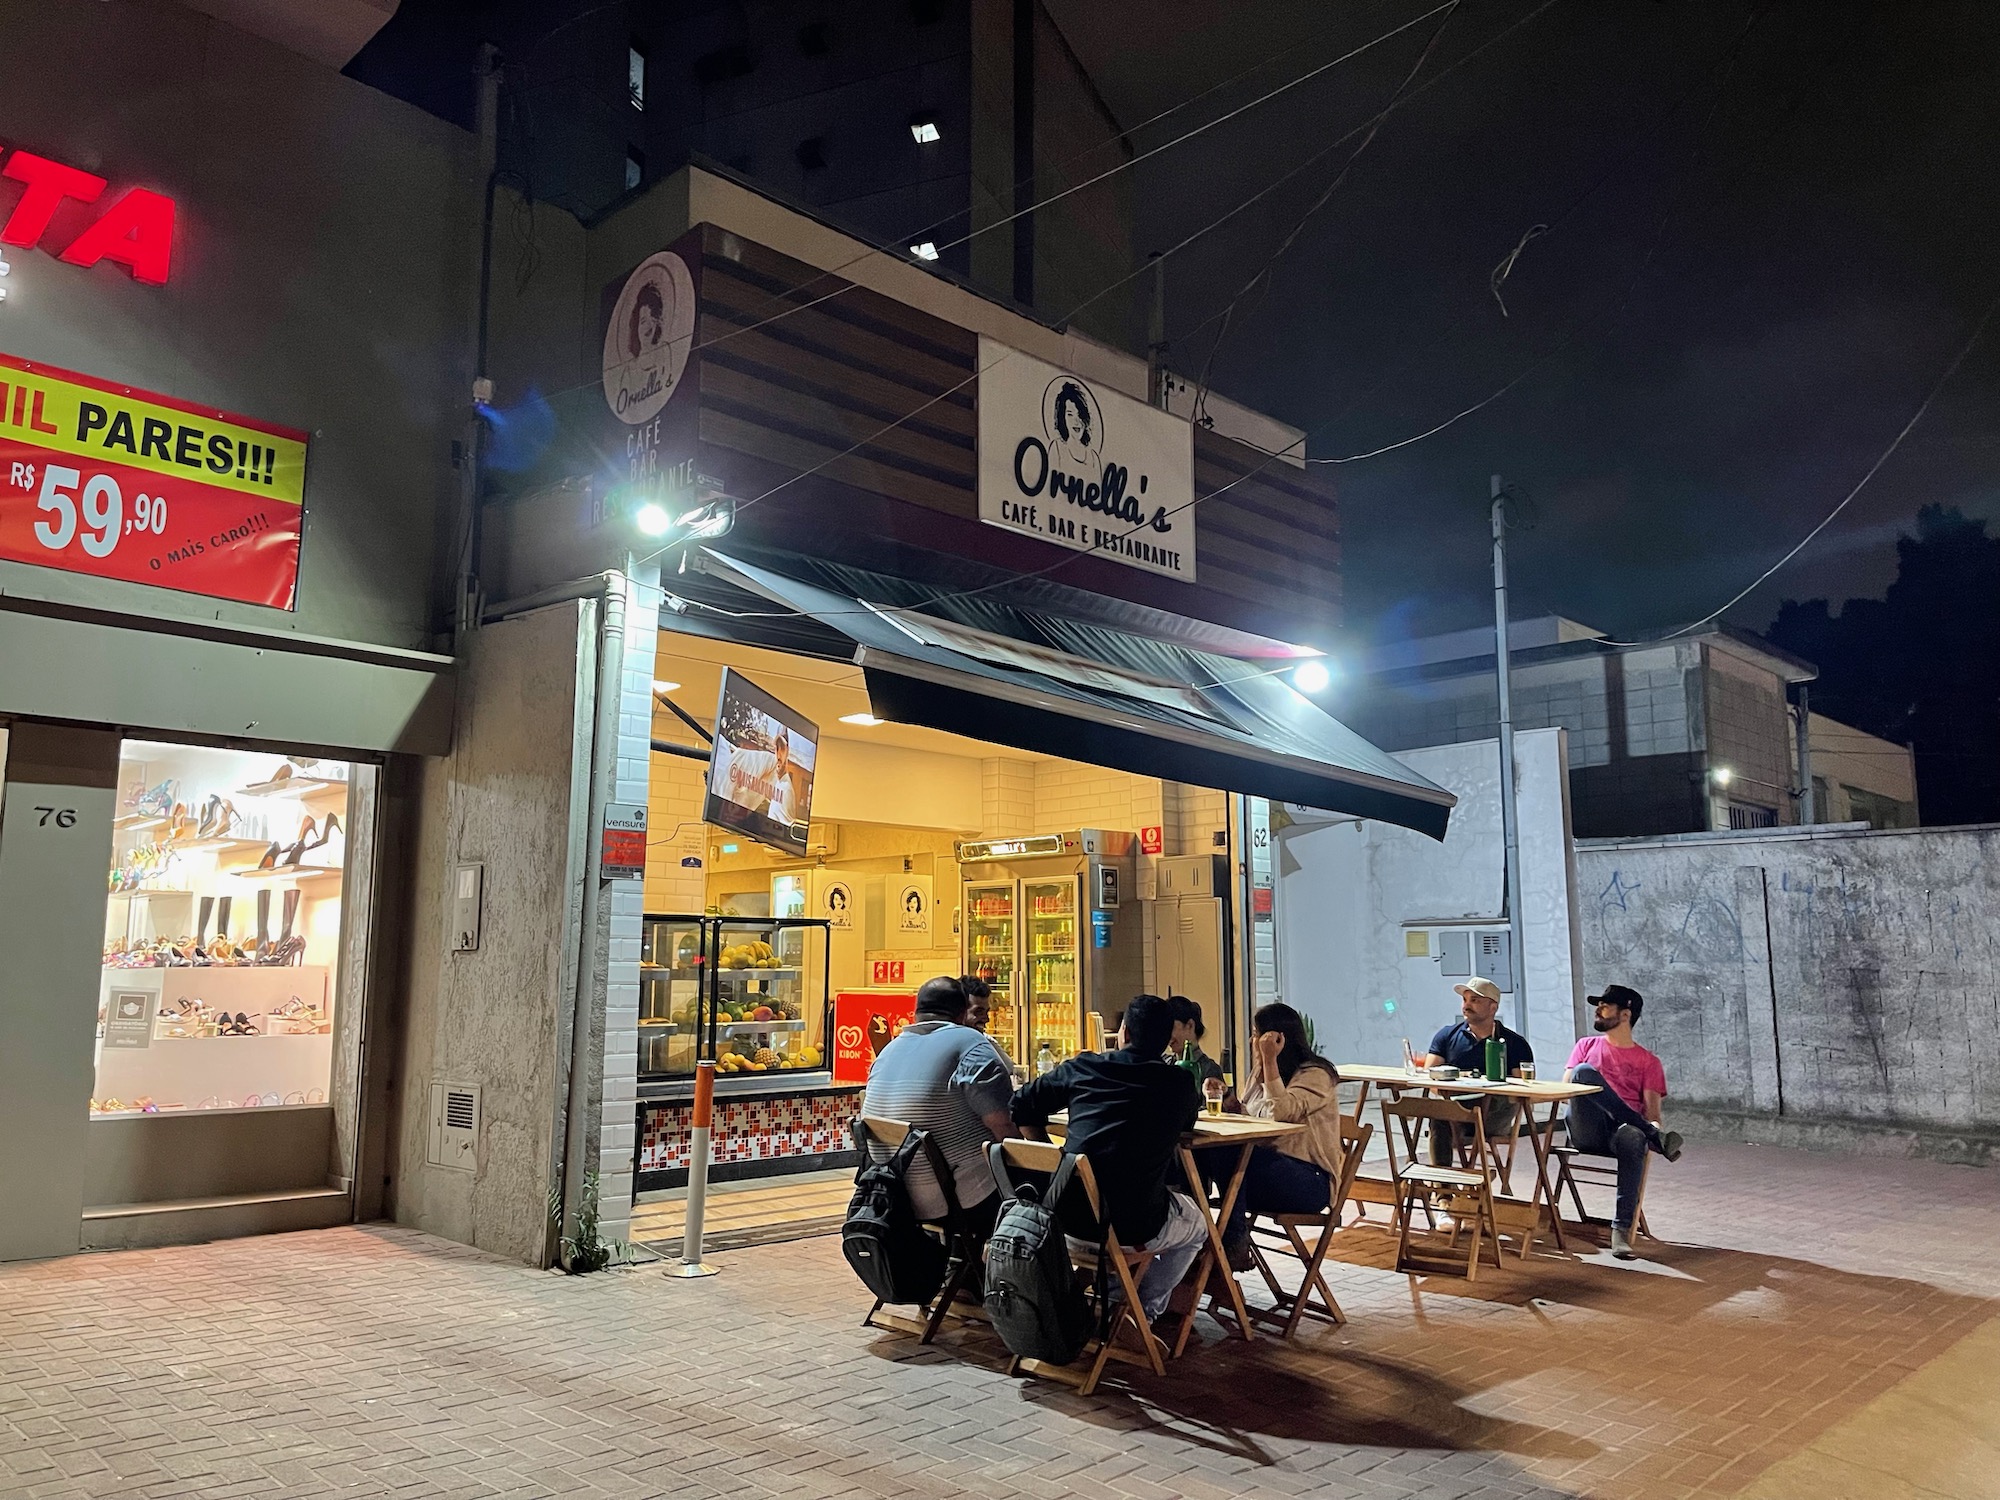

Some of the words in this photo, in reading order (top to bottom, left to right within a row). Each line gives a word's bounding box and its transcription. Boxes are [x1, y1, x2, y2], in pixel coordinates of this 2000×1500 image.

[0, 145, 176, 286] TA
[616, 366, 674, 415] Ornella's
[0, 381, 58, 435] IL
[76, 401, 275, 485] PARES!!!
[627, 416, 661, 458] CAFÉ
[10, 462, 35, 492] R$
[630, 449, 657, 481] BAR
[1014, 436, 1172, 533] Ornella's
[150, 559, 161, 571] O
[210, 512, 270, 548] CARO!!!
[1002, 500, 1043, 532] CAFÉ,
[1049, 514, 1075, 540] BAR
[1081, 525, 1089, 544] E
[1095, 528, 1181, 571] RESTAURANTE
[34, 806, 78, 828] 76
[1254, 827, 1267, 848] 62
[839, 1049, 861, 1059] KIBON
